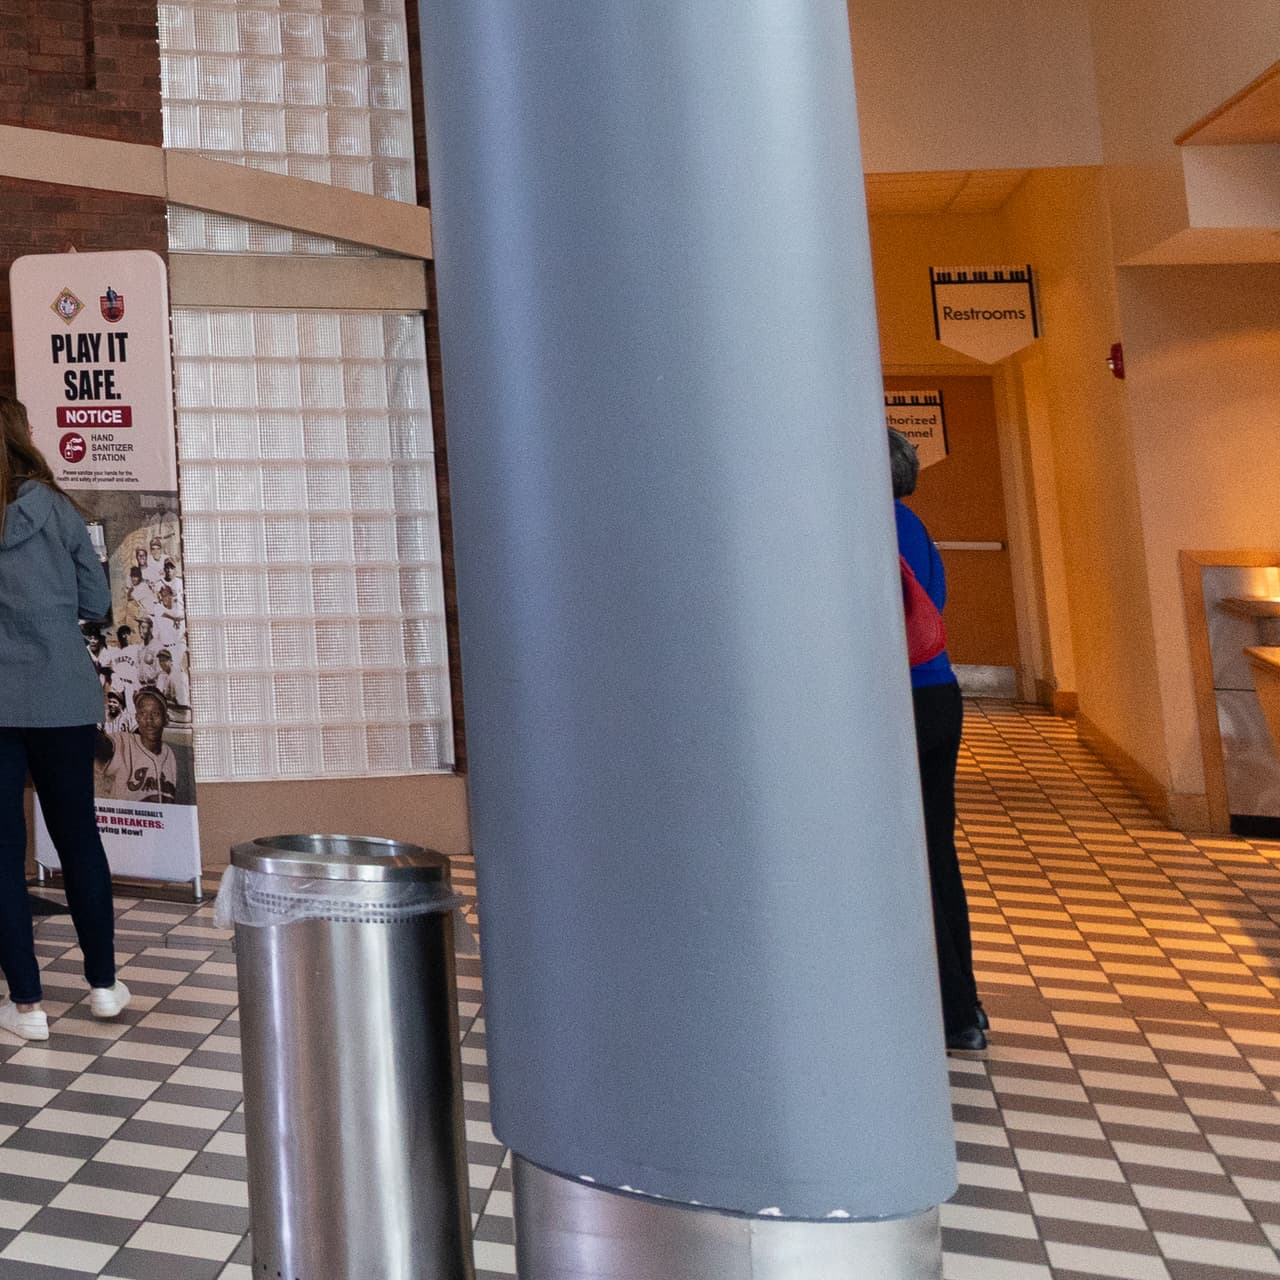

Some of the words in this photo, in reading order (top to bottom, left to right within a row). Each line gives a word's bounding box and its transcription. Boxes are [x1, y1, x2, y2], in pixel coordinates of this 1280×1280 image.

[943, 306, 1026, 321] Restrooms
[51, 333, 101, 364] PLAY
[107, 332, 128, 363] IT
[64, 370, 121, 400] SAFE.
[66, 410, 122, 424] NOTICE
[886, 414, 936, 425] thorized
[902, 428, 933, 438] onnel
